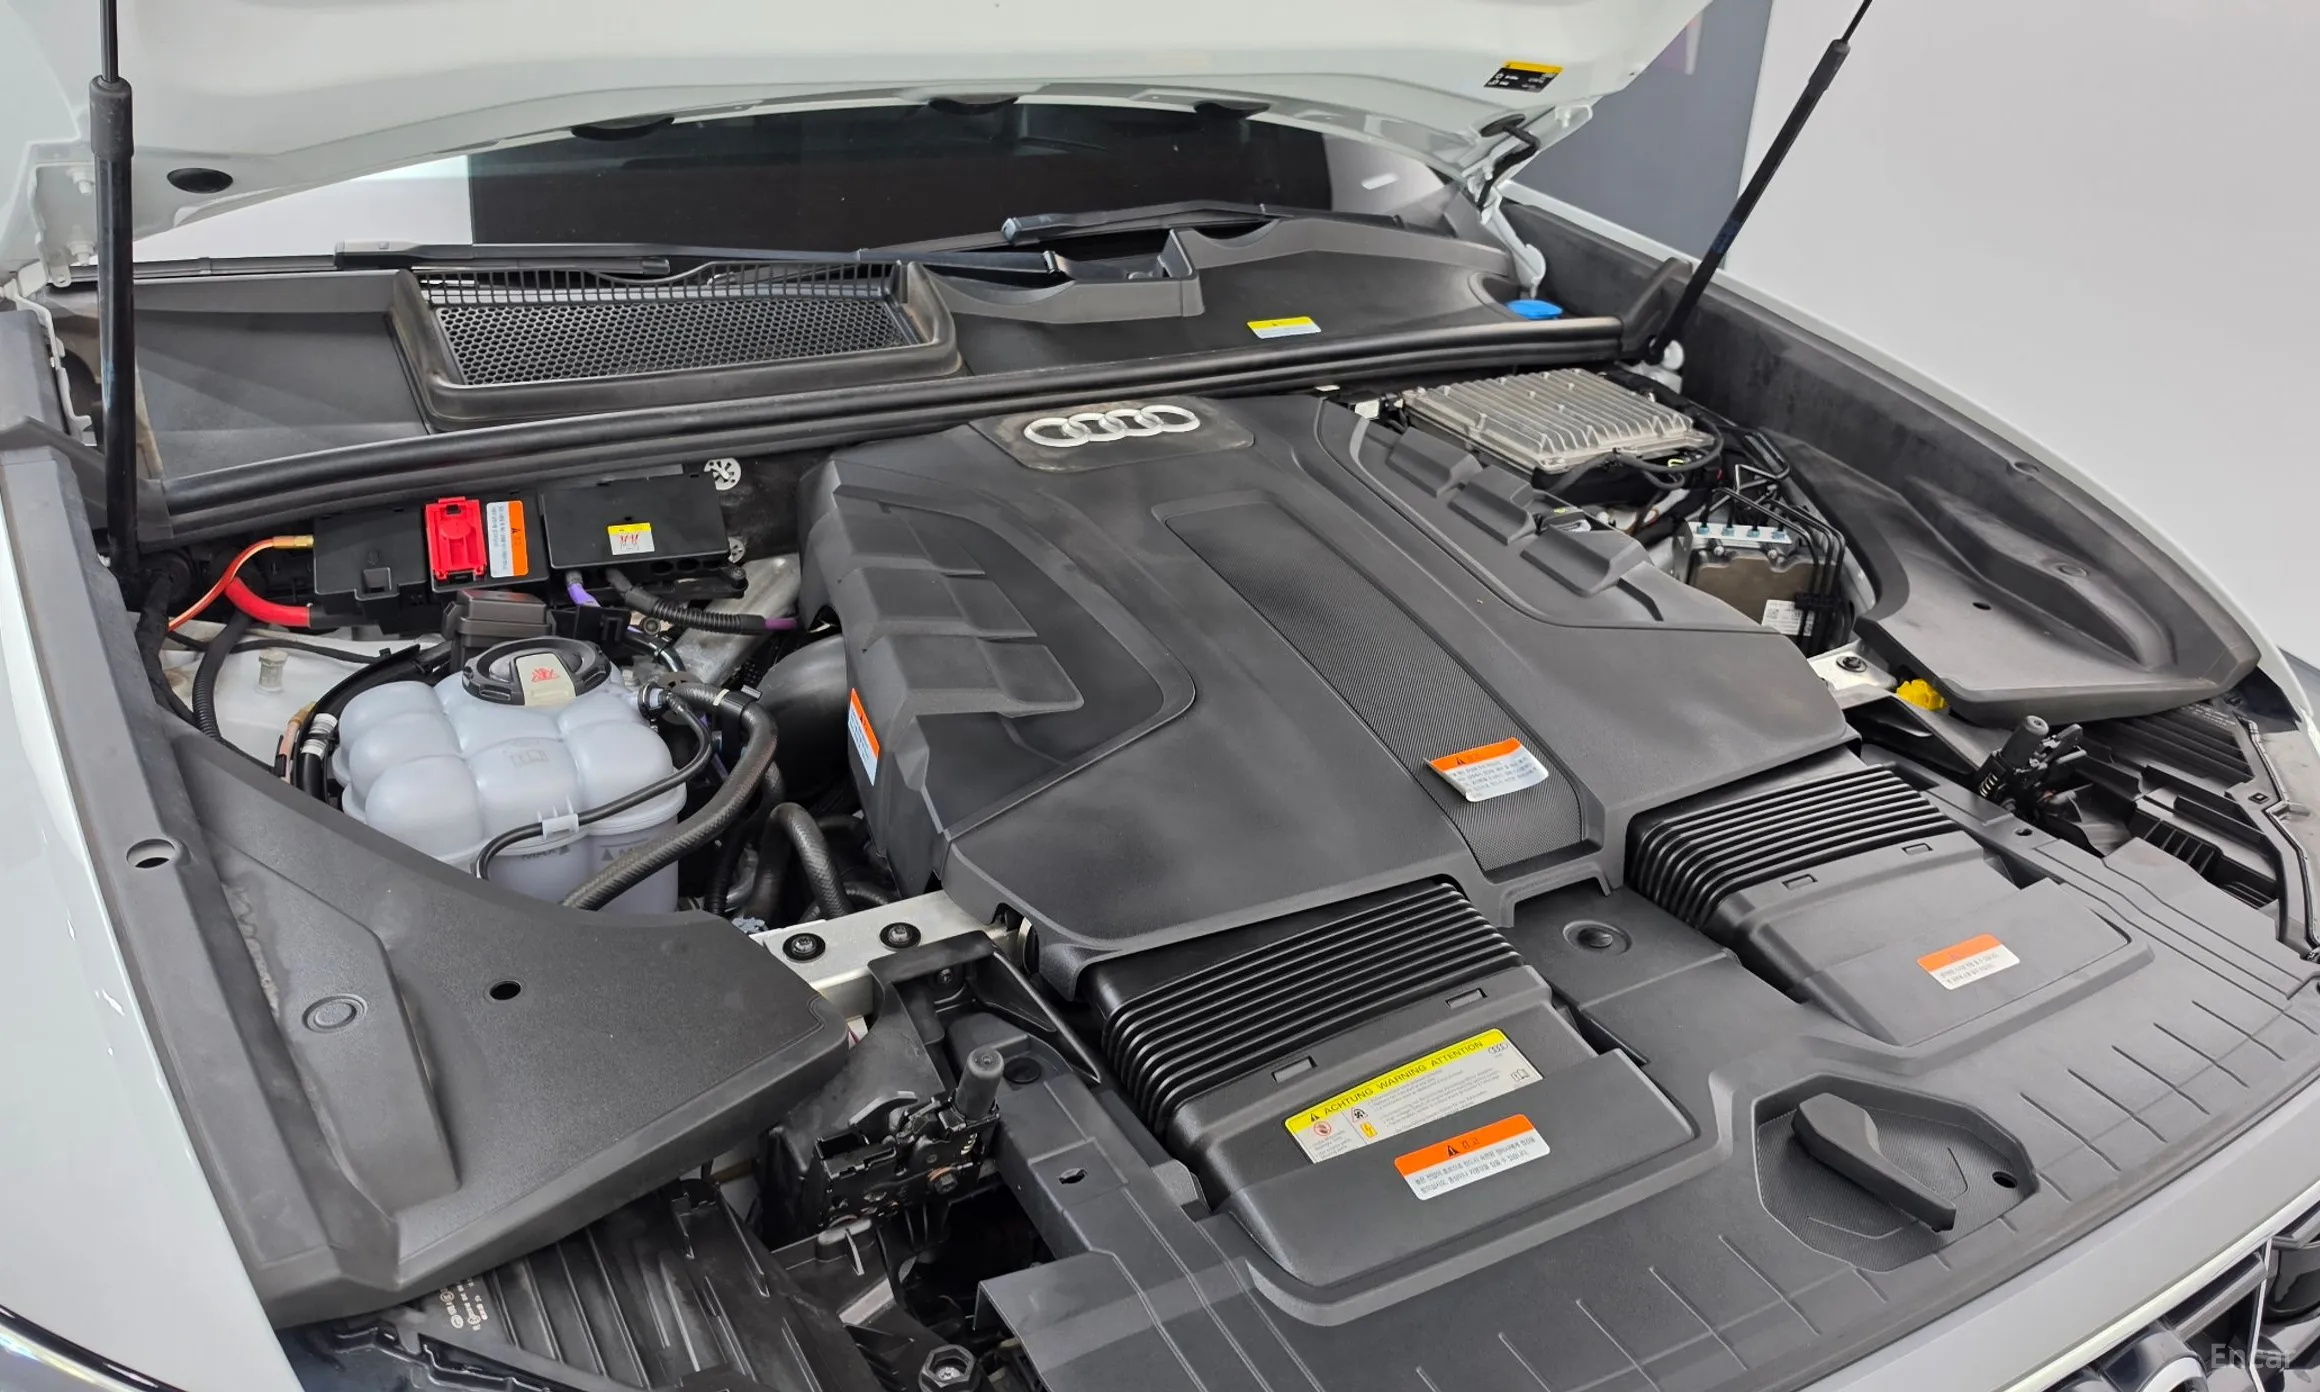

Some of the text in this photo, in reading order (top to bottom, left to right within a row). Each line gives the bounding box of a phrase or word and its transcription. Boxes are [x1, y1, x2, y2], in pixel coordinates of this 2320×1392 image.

[1323, 1088, 1374, 1116] ACHTUNG
[1377, 1064, 1427, 1090] WARNING
[1431, 1041, 1484, 1067] ATTENTION
